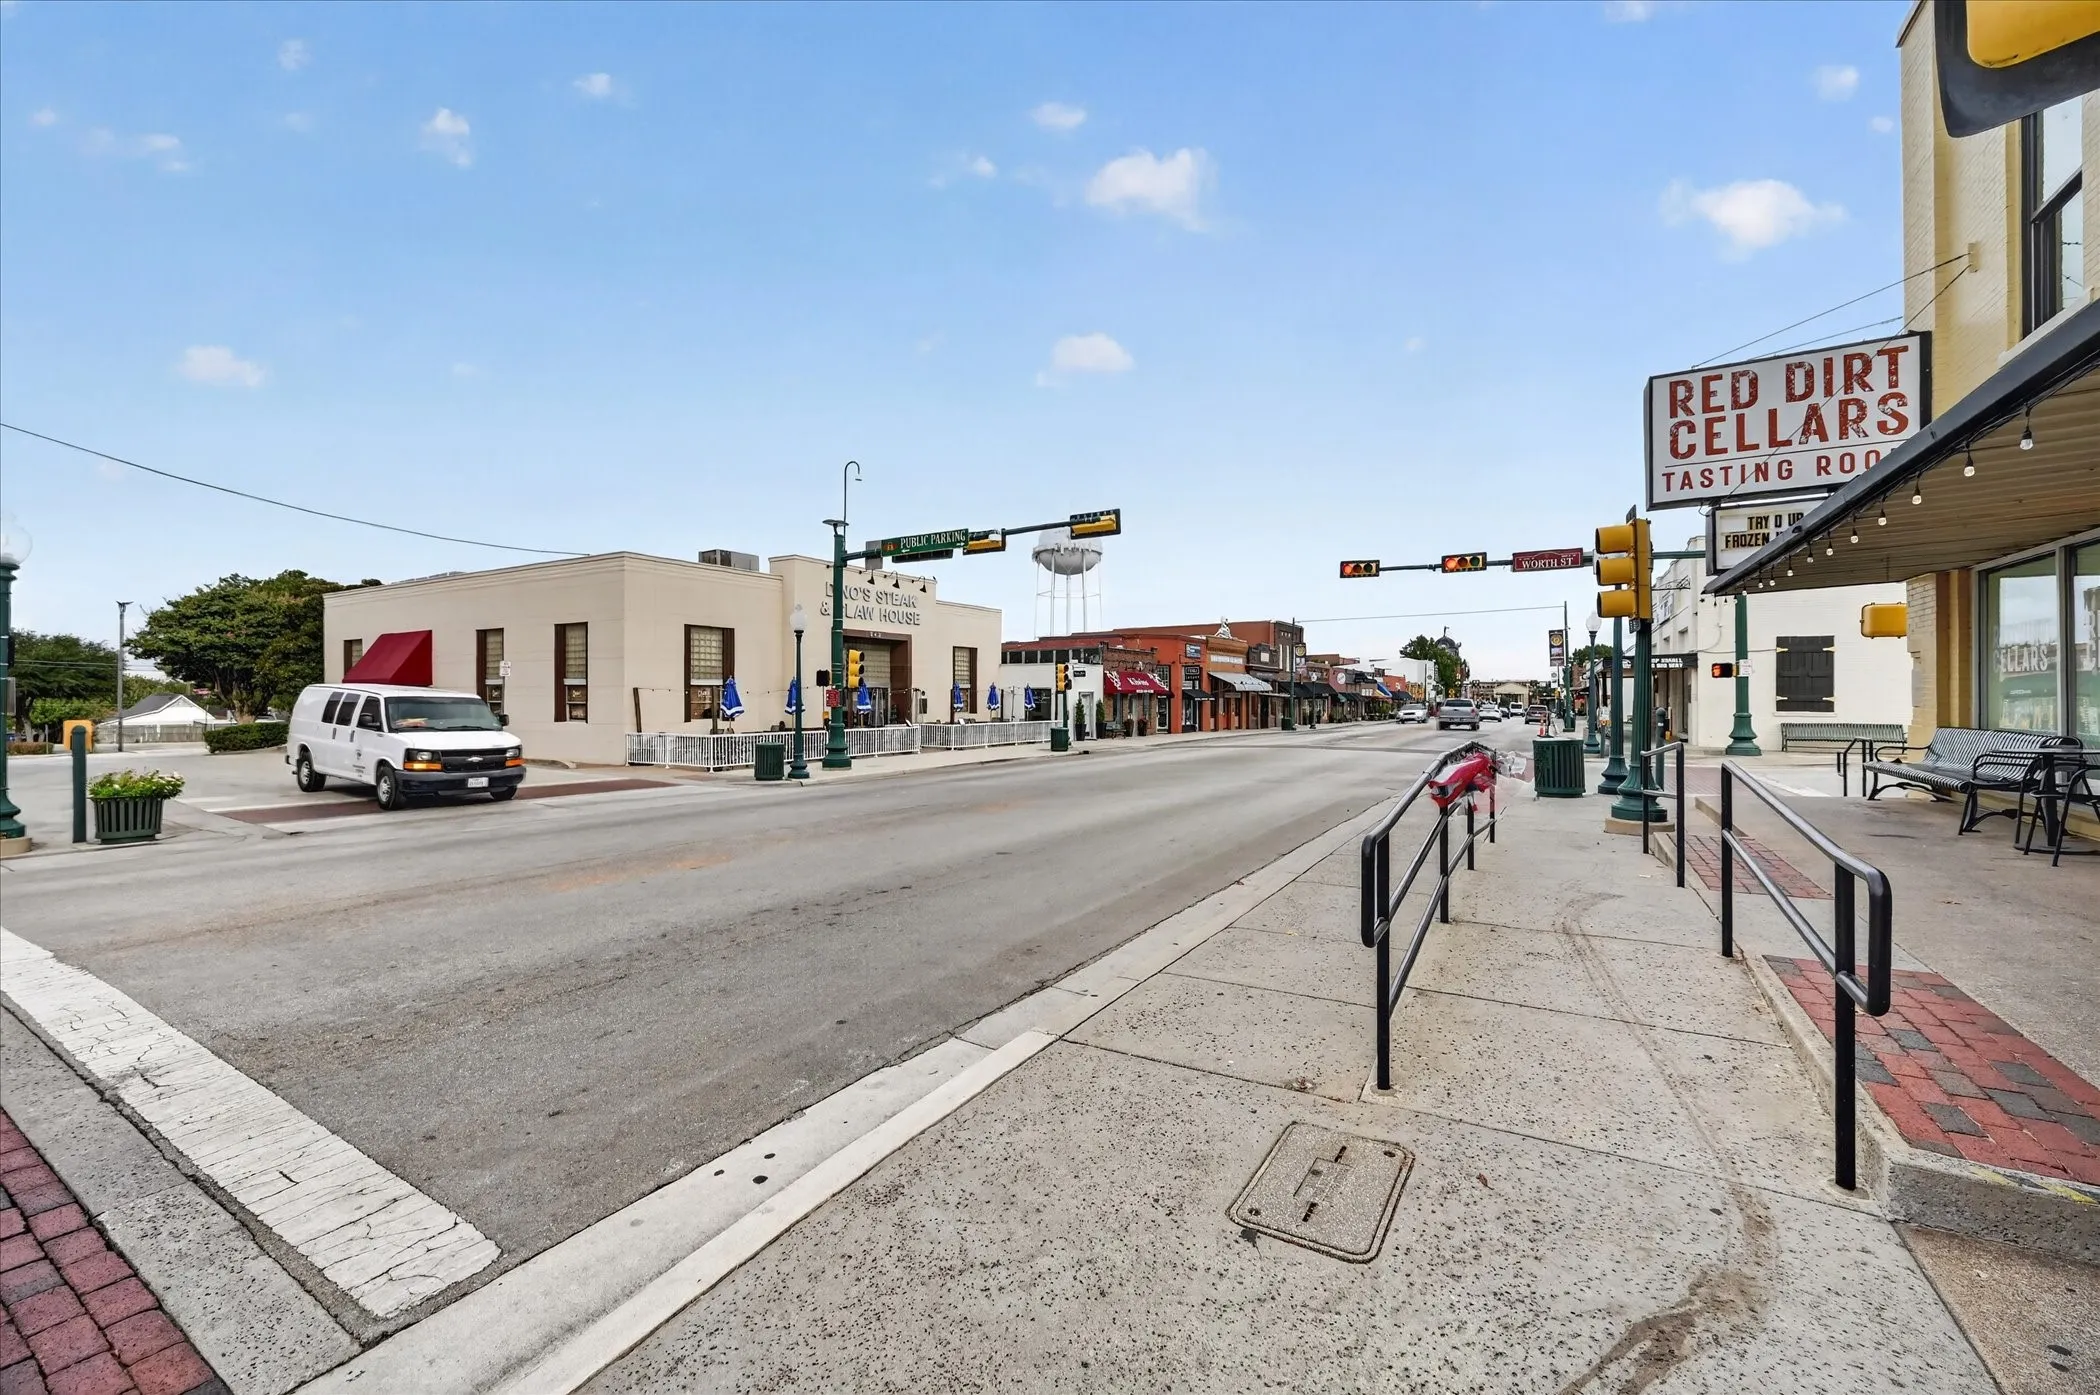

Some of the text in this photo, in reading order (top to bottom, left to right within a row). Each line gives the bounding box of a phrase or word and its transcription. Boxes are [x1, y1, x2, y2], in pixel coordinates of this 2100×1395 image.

[1669, 345, 1909, 419] RED DIRT
[1669, 391, 1909, 460] CELLARS
[1661, 449, 1893, 493] TASTING ROO
[1747, 515, 1770, 530] TRY
[900, 530, 966, 549] PUBLIC PARKING
[1725, 532, 1770, 548] FROZEN
[1522, 558, 1558, 569] WORTH
[1560, 556, 1574, 567] ST
[826, 581, 917, 609] DNO'S STEAK
[820, 600, 921, 626] & LAW HOUSE
[1993, 645, 2048, 673] CELLARS
